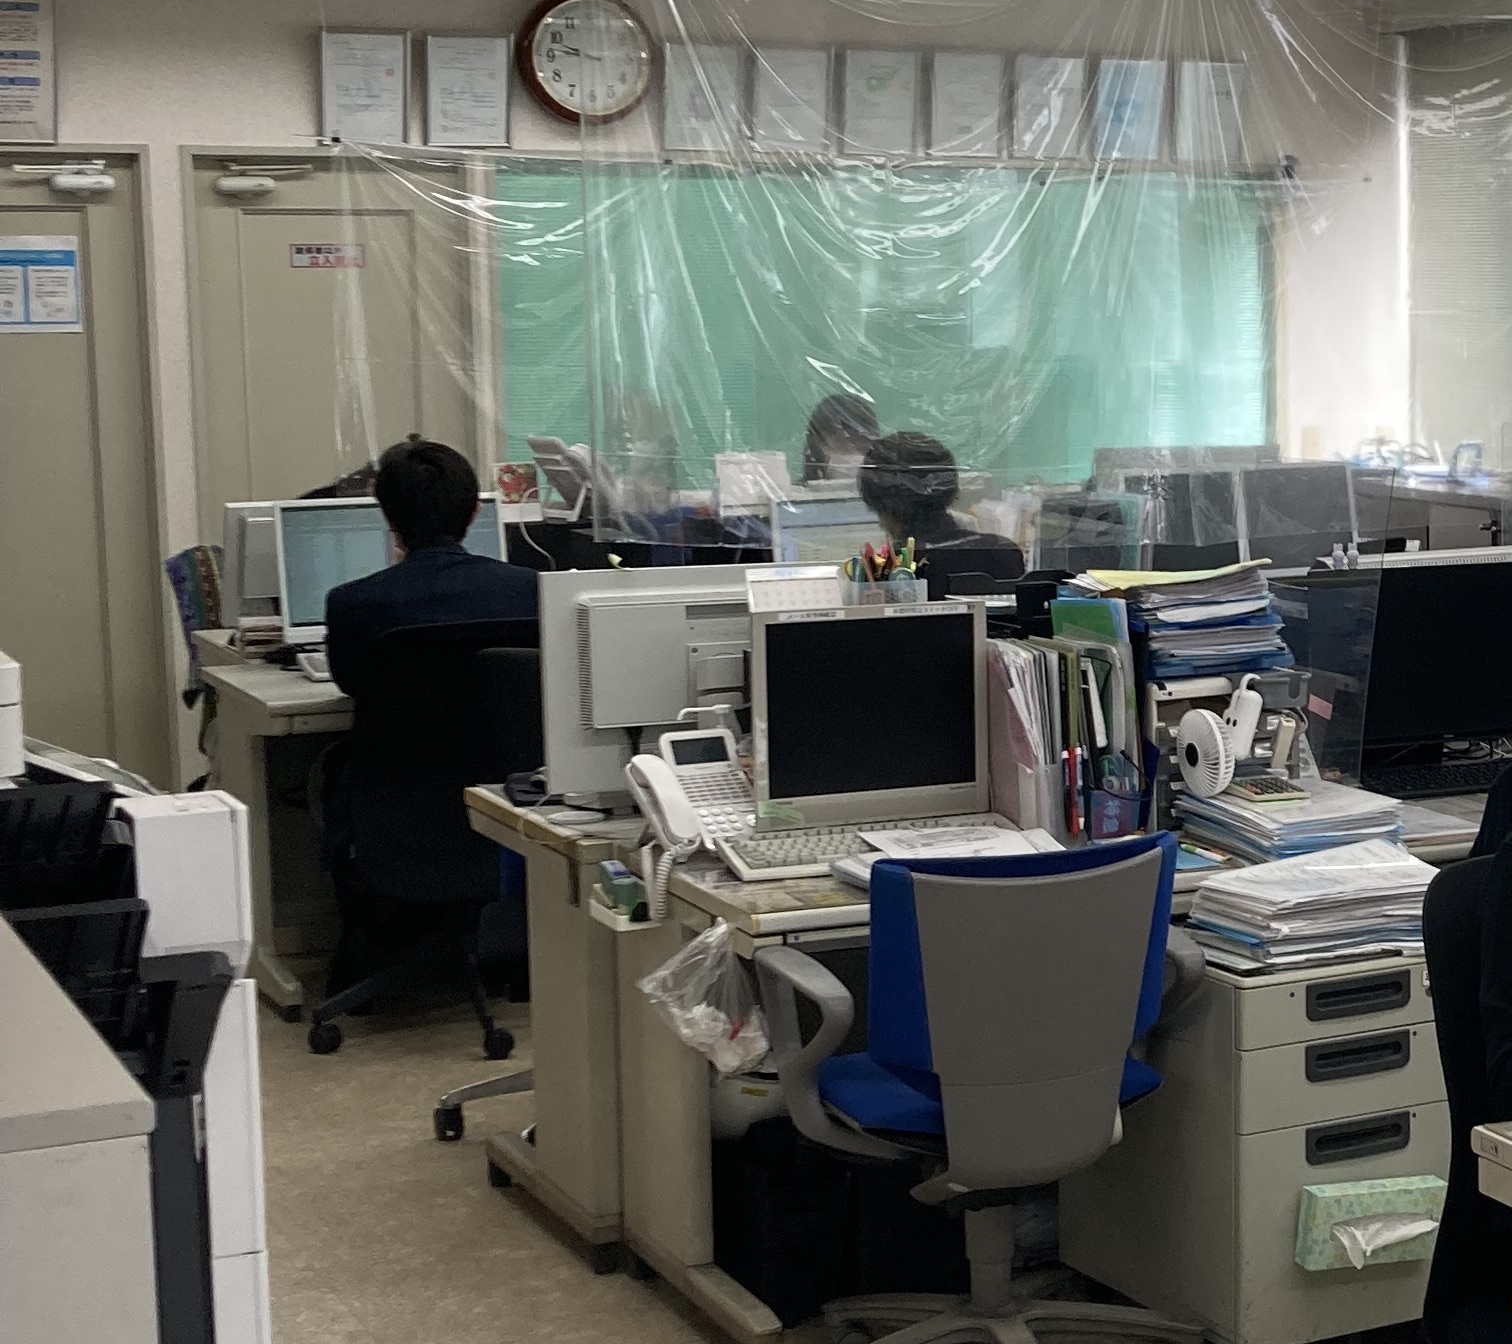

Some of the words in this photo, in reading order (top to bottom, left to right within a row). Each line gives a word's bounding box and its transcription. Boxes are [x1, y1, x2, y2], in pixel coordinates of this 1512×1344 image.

[565, 16, 576, 30] 11
[550, 31, 563, 44] 10
[546, 48, 556, 63] 9
[552, 69, 562, 83] 8
[568, 84, 576, 98] 7
